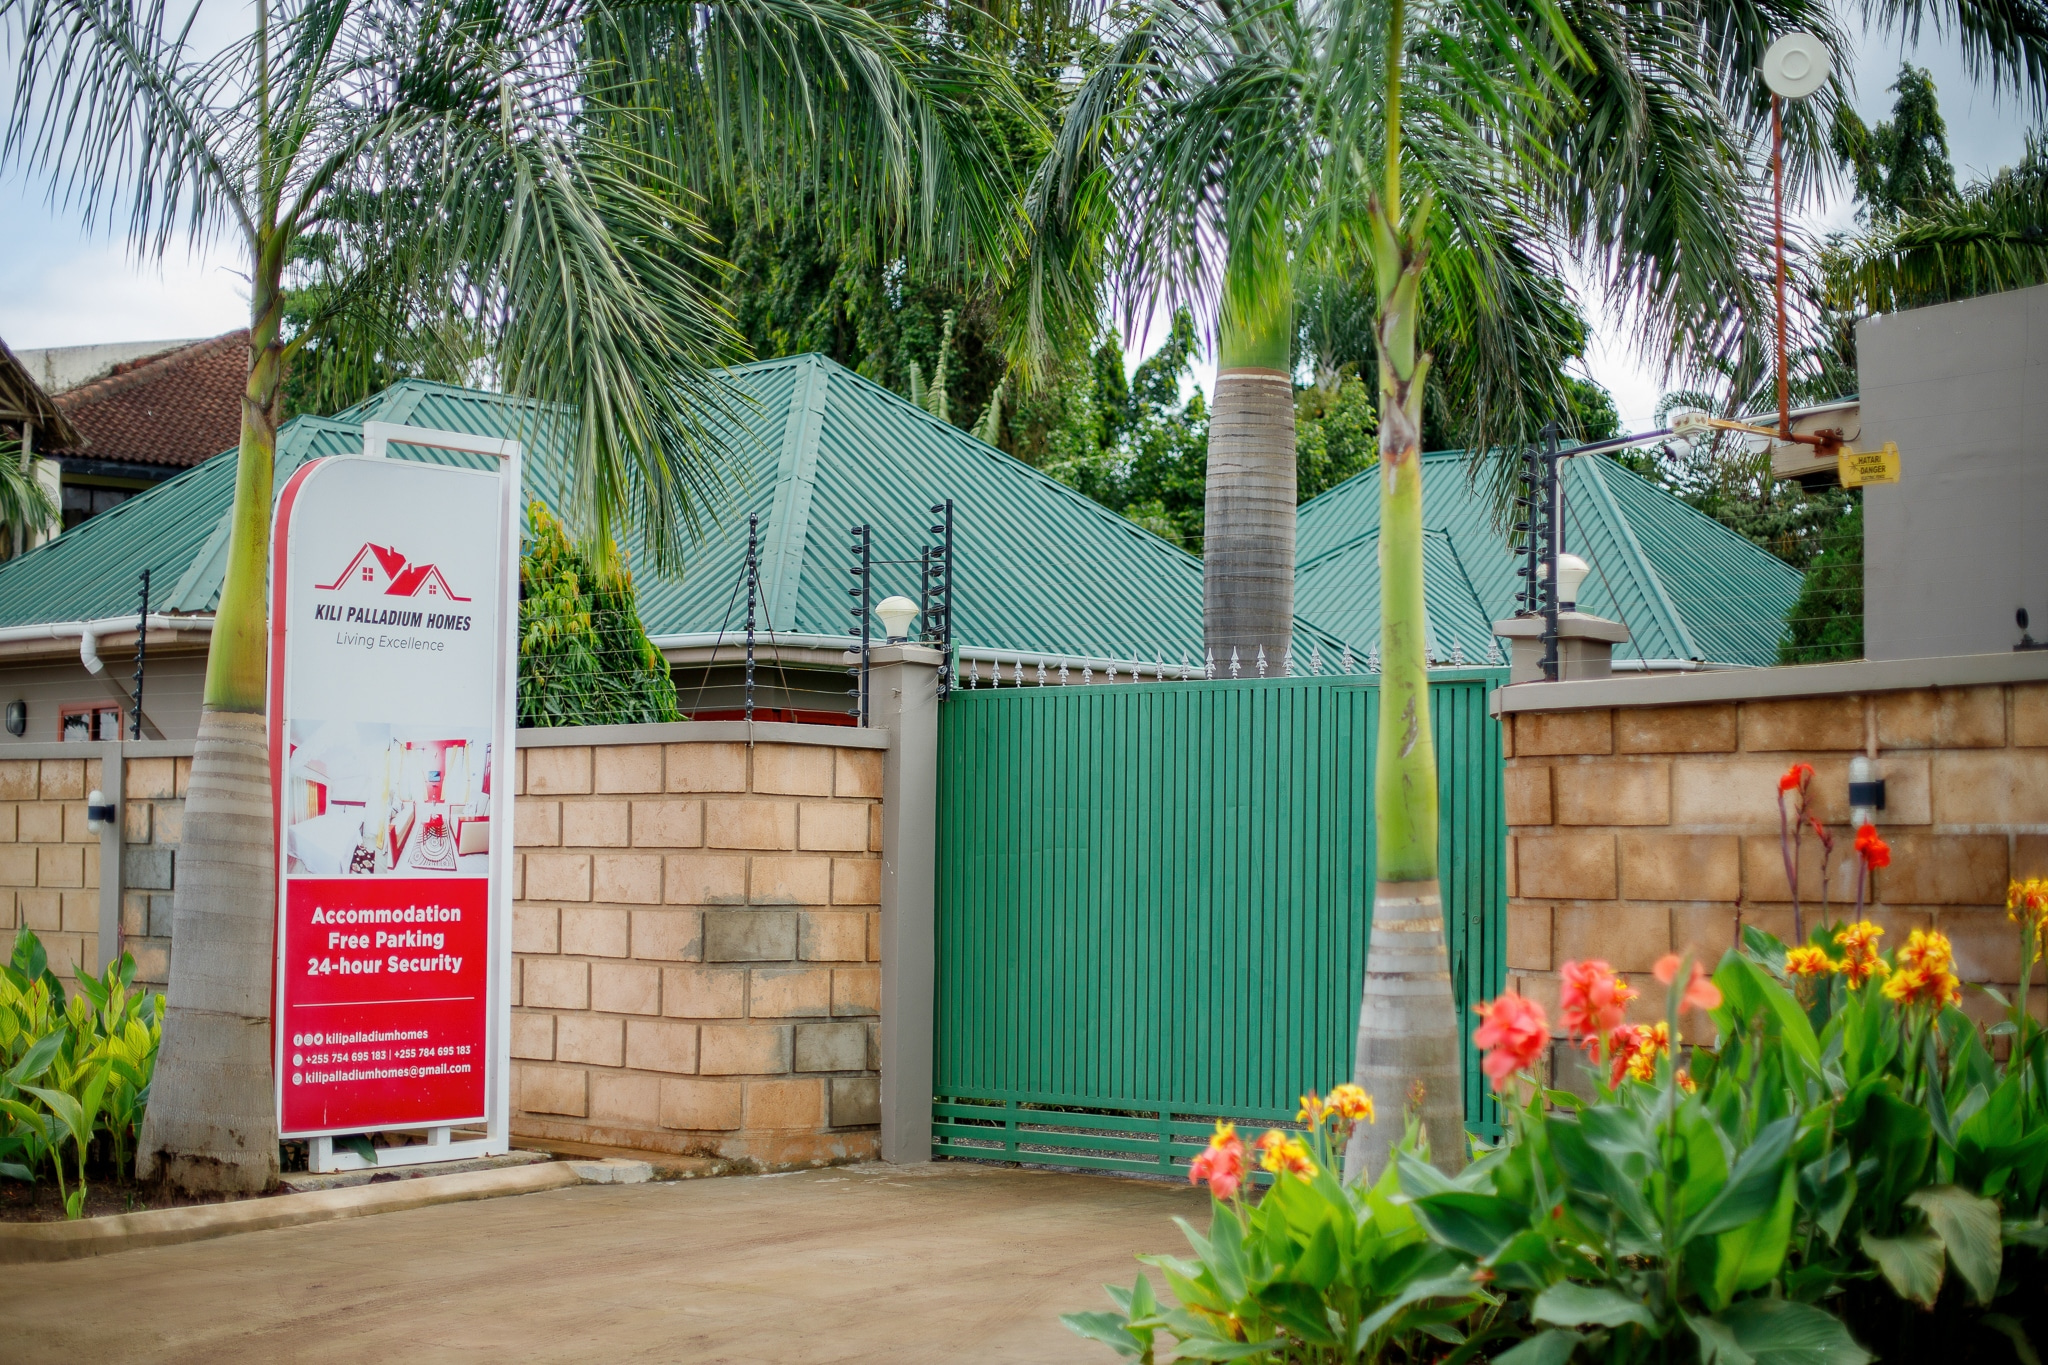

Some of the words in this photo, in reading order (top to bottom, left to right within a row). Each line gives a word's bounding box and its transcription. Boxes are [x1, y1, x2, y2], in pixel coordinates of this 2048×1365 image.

[1858, 455, 1882, 464] HATARI
[1860, 465, 1886, 474] DANGER
[314, 603, 343, 621] KILI
[346, 606, 423, 628] PALLADIUM
[426, 613, 472, 631] HOMES
[336, 632, 375, 649] Living
[378, 635, 445, 652] Excellence
[311, 905, 461, 925] Accommodation
[328, 931, 370, 950] Free
[375, 929, 444, 950] Parking
[307, 956, 382, 976] 24-hour
[387, 953, 463, 973] Security
[325, 1029, 429, 1046] kilipalladiumhomes
[305, 1054, 329, 1065] +255
[331, 1053, 349, 1063] 754
[351, 1052, 369, 1062] 695
[371, 1050, 386, 1060] 183
[394, 1049, 416, 1059] +255
[418, 1048, 435, 1057] 784
[437, 1047, 454, 1056] 695
[456, 1045, 471, 1055] 183
[305, 1062, 471, 1084] kilipalladiumhomes@gmail.com
